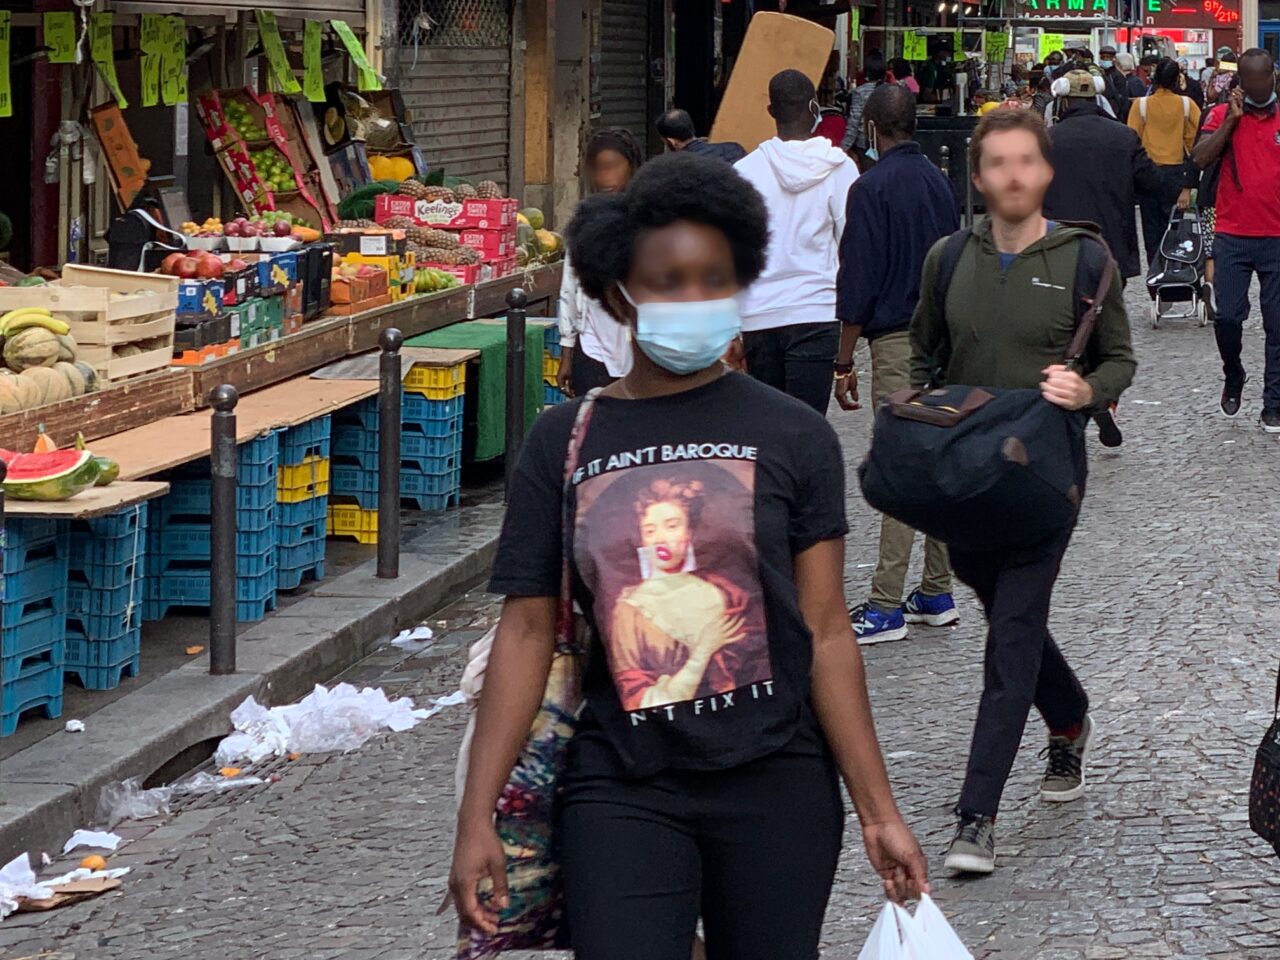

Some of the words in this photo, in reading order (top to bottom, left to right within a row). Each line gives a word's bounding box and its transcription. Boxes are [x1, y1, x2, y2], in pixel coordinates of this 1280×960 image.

[417, 203, 458, 218] Keelings
[572, 466, 585, 485] IF
[587, 459, 602, 475] IT
[605, 446, 657, 471] AIN'T
[661, 443, 758, 462] BAROQUE
[630, 706, 675, 727] N'T
[694, 691, 737, 716] FIX
[751, 680, 775, 699] IT
